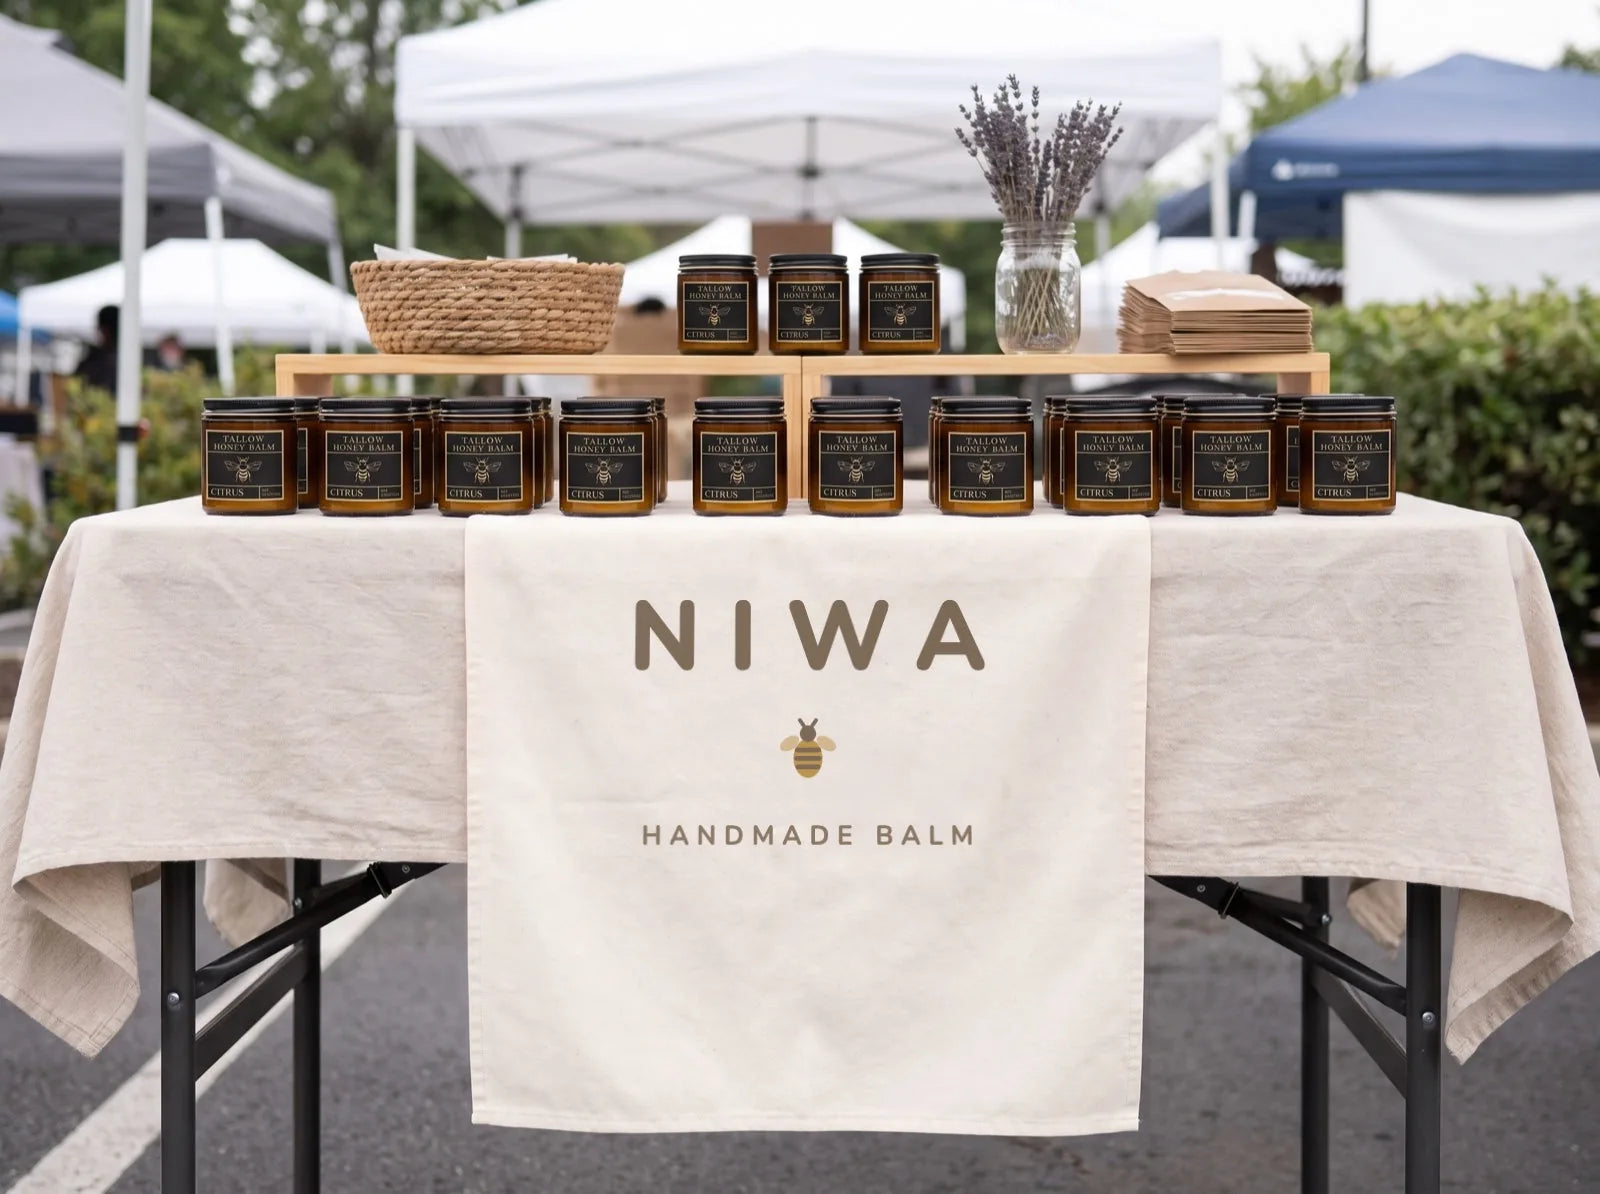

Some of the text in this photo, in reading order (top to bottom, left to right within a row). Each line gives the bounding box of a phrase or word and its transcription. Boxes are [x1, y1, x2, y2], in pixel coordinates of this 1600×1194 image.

[223, 435, 264, 443] TALLOW
[837, 436, 878, 444] TALLOW
[966, 437, 1007, 445] TALLOW
[1331, 435, 1372, 443] TALLOW
[214, 443, 275, 451] HONEY BALM
[369, 443, 394, 451] BALM
[574, 445, 635, 453] HONEY BALM
[708, 445, 769, 453] HONEY BALM
[956, 445, 987, 453] HONEY
[1321, 443, 1352, 451] HONEY
[211, 488, 244, 496] CITRUS
[330, 489, 363, 497] CITRUS
[449, 489, 482, 498] CITRUS
[572, 490, 604, 499] CITRUS
[704, 490, 738, 498] CITRUS
[823, 489, 857, 497] CITRUS
[954, 490, 987, 498] CITRUS
[1080, 489, 1113, 497] CITRUS
[1198, 489, 1231, 497] CITRUS
[635, 599, 985, 671] NIWA
[643, 825, 973, 846] HANDMADE BALM
